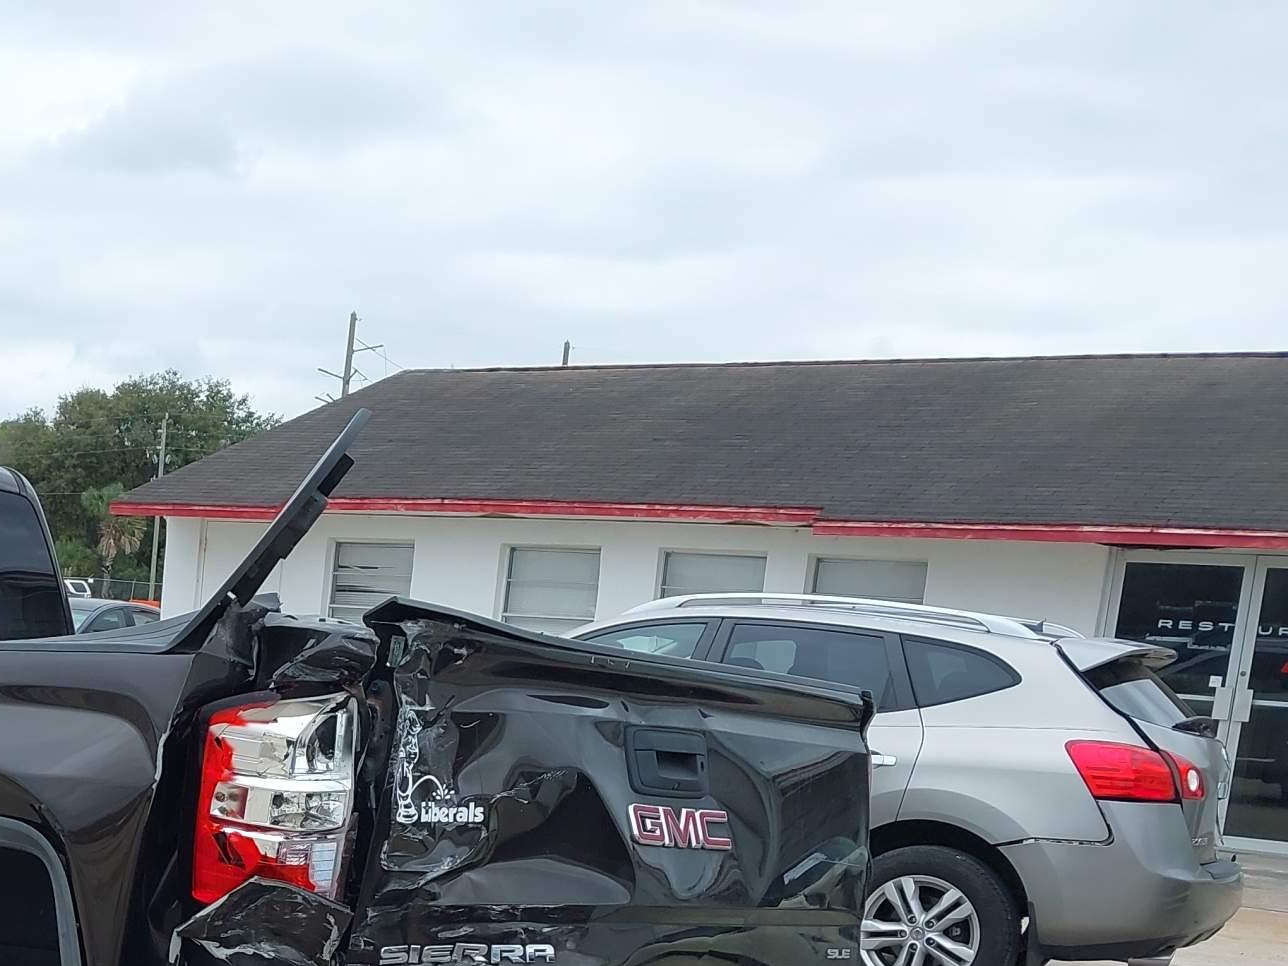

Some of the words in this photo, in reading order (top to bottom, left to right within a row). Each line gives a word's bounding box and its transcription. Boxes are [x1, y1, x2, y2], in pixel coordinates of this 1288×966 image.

[420, 802, 484, 823] Liberals
[628, 804, 732, 850] GMC
[379, 943, 556, 965] SIERRA
[827, 948, 851, 959] SLE
